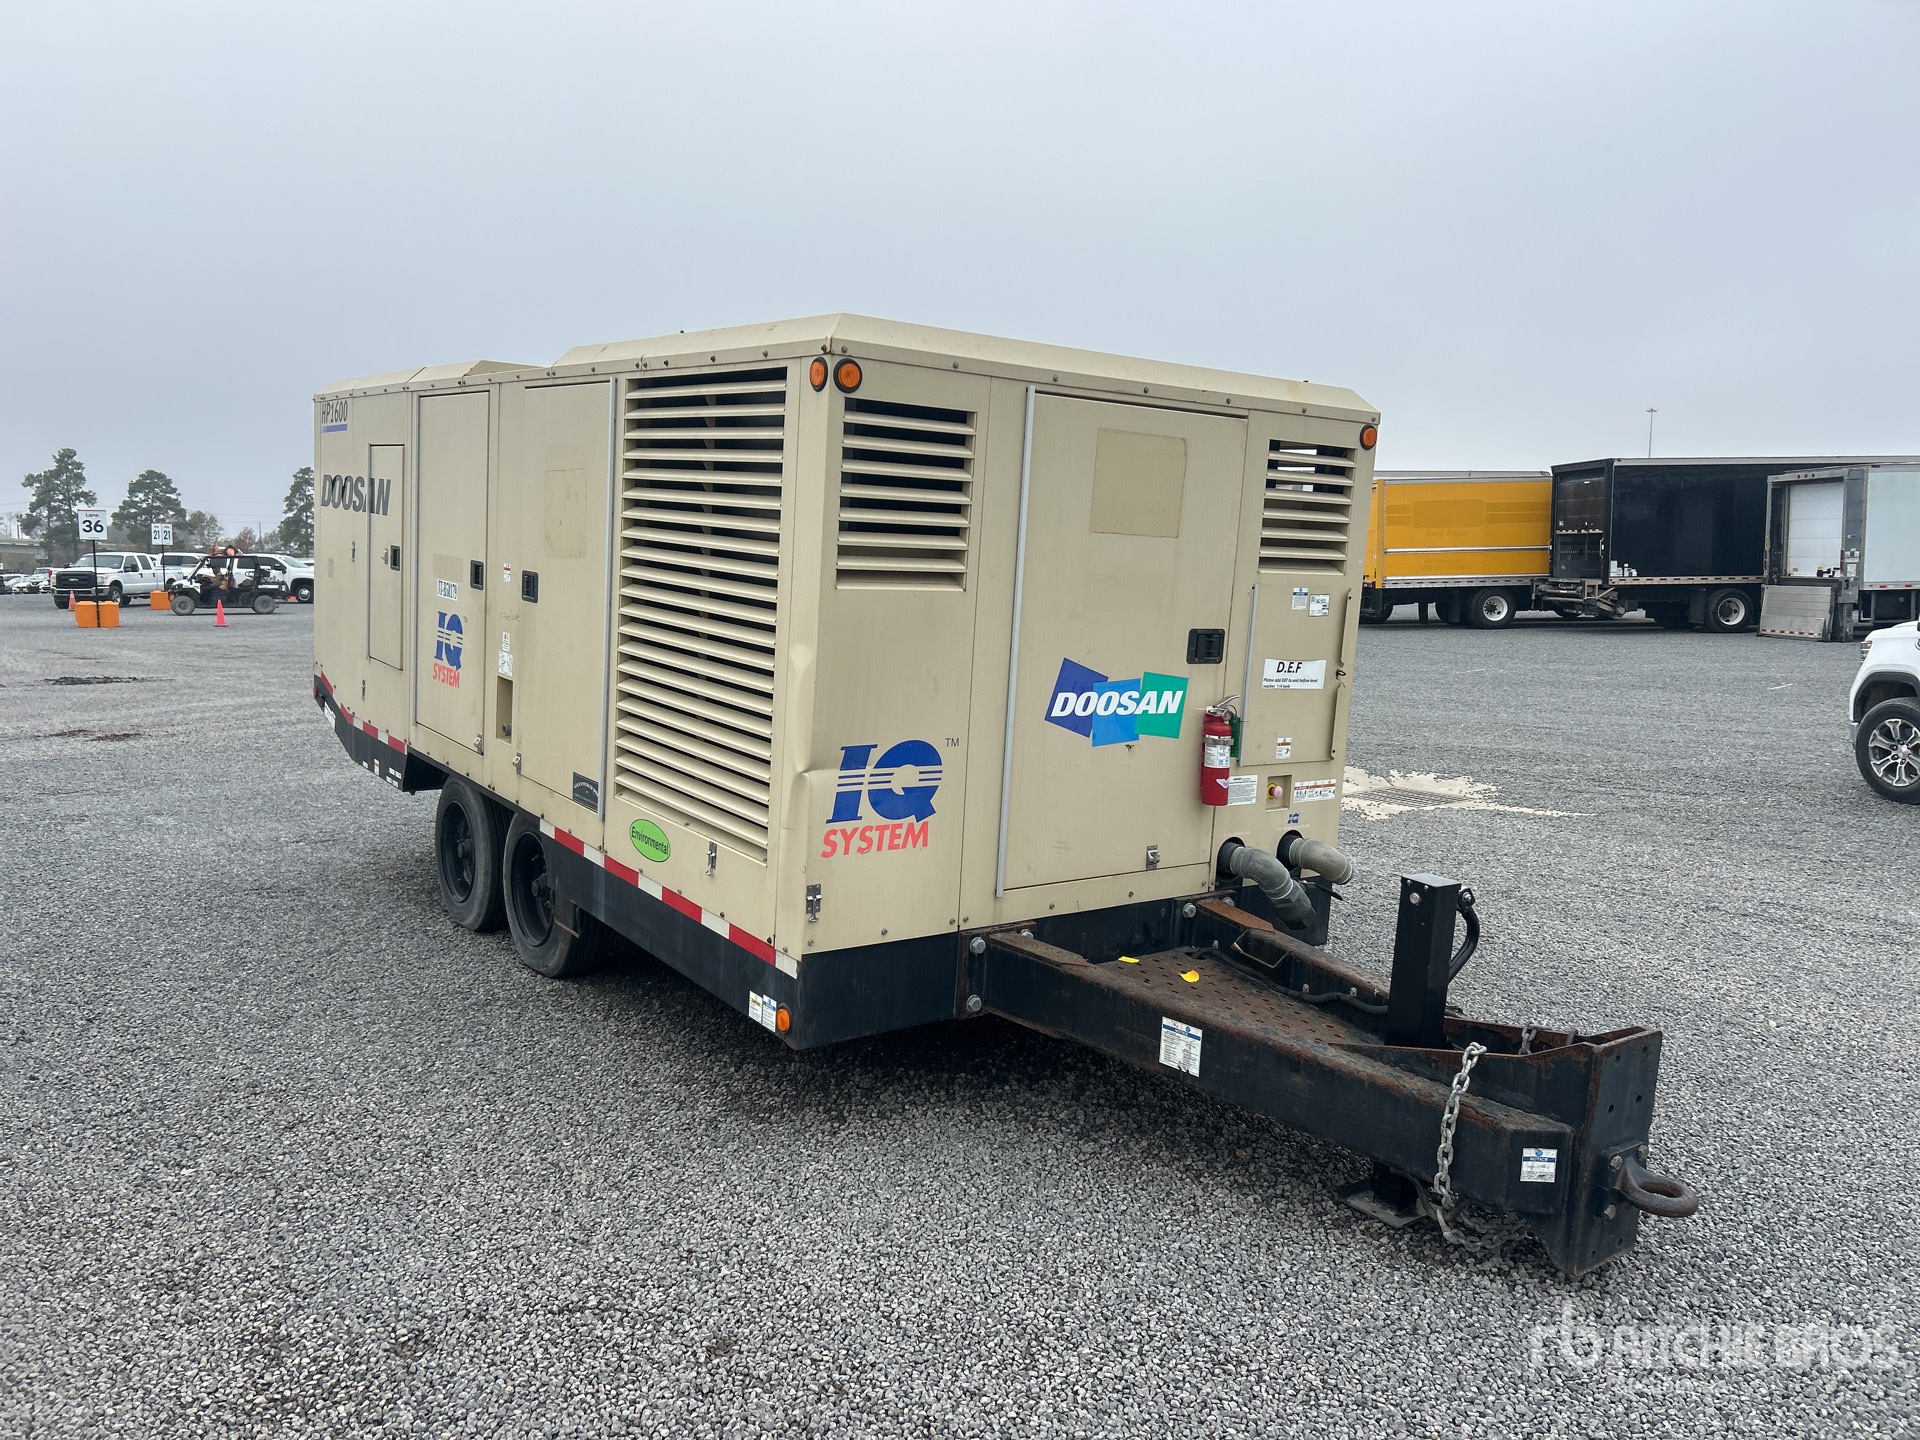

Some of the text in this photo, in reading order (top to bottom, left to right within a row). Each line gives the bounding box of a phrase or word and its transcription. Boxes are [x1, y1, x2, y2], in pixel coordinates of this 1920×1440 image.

[321, 400, 348, 424] HP1600
[321, 474, 391, 516] DOOSAN
[82, 519, 104, 532] 36
[153, 530, 160, 540] 21
[164, 530, 171, 540] 21
[432, 662, 461, 689] SYSTEM
[1277, 661, 1303, 673] D.E.F
[1050, 690, 1183, 717] DOOSAN
[945, 737, 960, 747] TM
[825, 739, 943, 823] IQ
[631, 824, 669, 855] Environmental
[820, 821, 929, 859] SYSTEM
